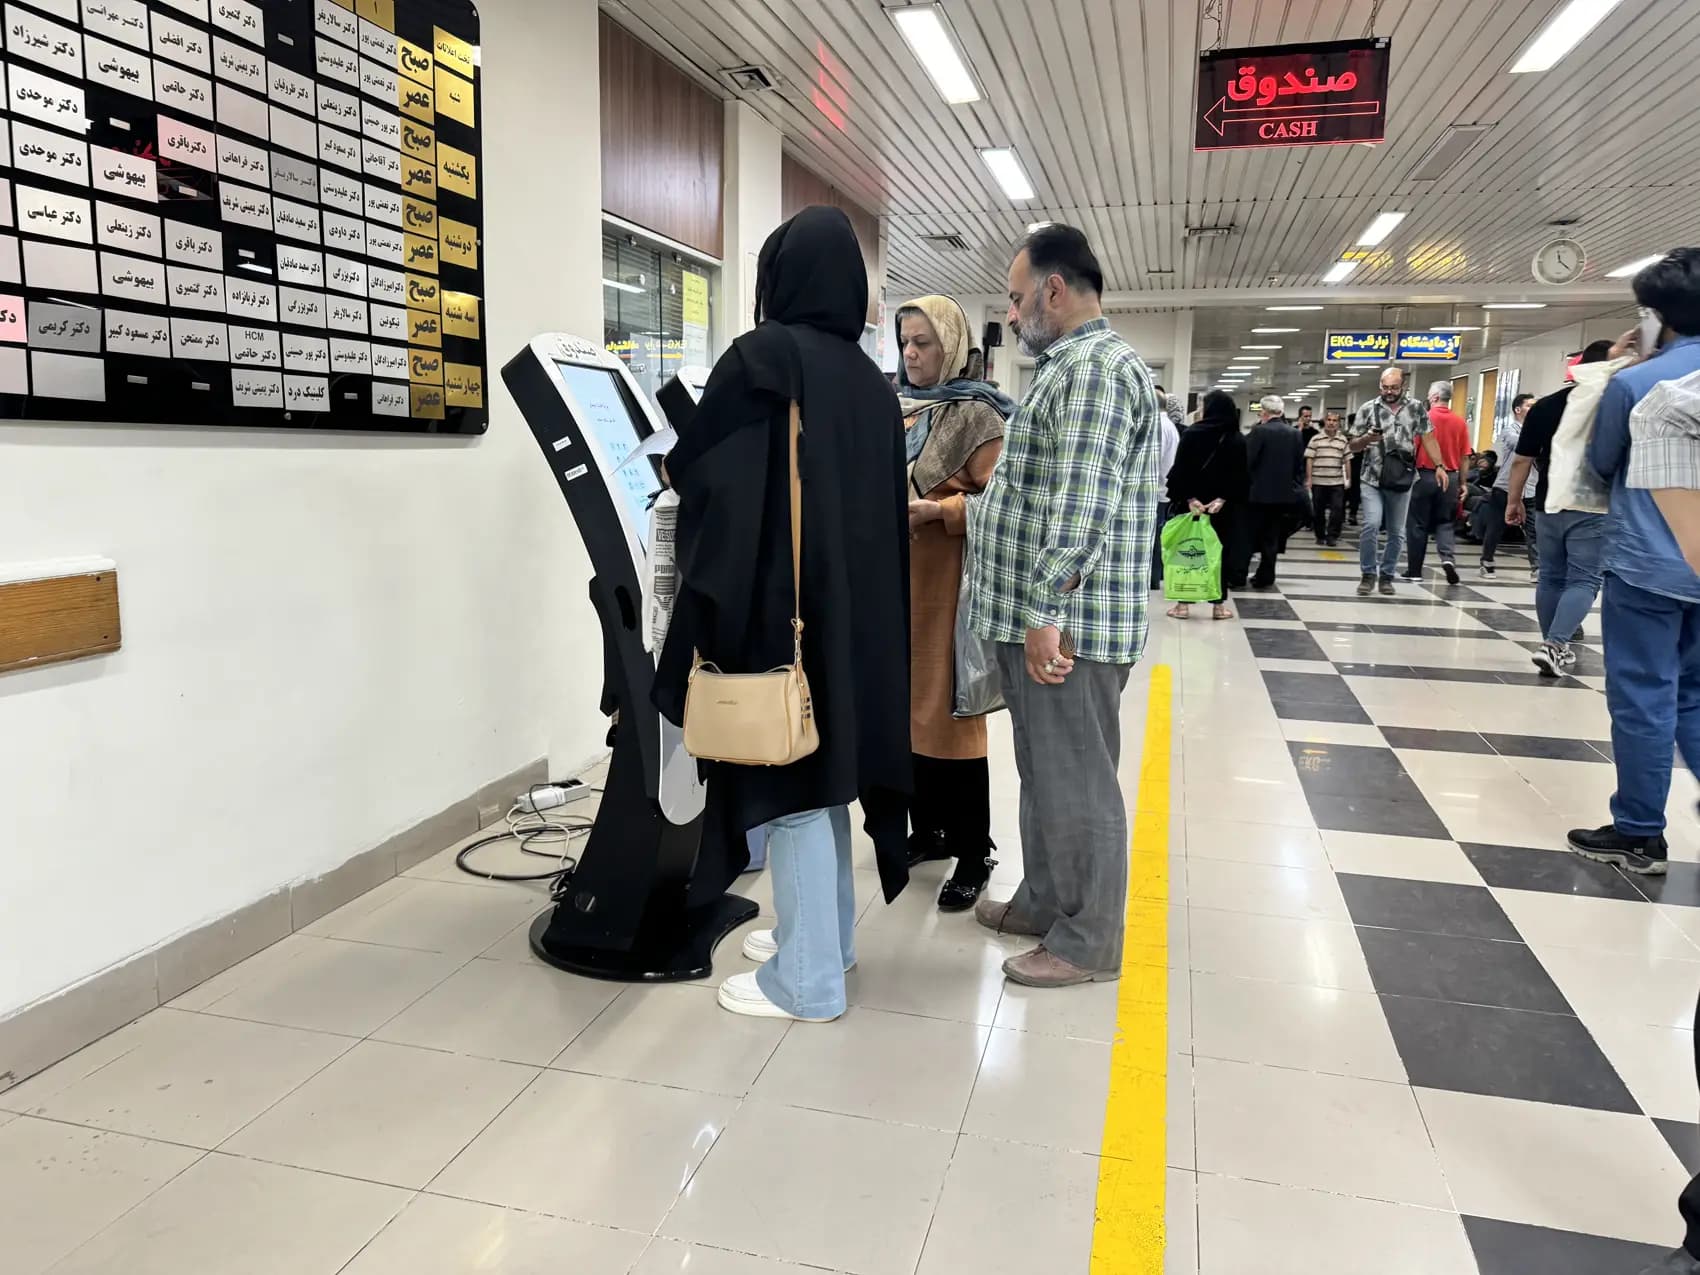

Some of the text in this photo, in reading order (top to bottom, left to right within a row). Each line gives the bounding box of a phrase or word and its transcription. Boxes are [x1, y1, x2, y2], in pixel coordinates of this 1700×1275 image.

[121, 17, 144, 29] دکتر
[242, 15, 256, 28] دکتر
[342, 22, 356, 34] دکتر
[13, 25, 75, 57] دکتر شیرزاد
[159, 32, 202, 54] دکتر افضلی
[385, 44, 397, 55] دکتر
[401, 46, 430, 73] صبح
[98, 57, 140, 83] بیهوشی
[249, 64, 260, 77] دکتر
[345, 61, 357, 73] دکتر
[385, 81, 396, 92] دکتر
[1226, 65, 1358, 106] صندوق
[188, 89, 205, 101] دکتر
[296, 87, 309, 99] دکتر
[402, 90, 430, 108] عصر
[57, 99, 78, 114] دکتر
[343, 106, 357, 117] دکتر
[388, 124, 399, 135] دکتر
[1258, 120, 1319, 139] CASH
[403, 125, 431, 151] صبح
[60, 152, 82, 166] دکتر
[346, 147, 356, 158] دکتر
[249, 160, 264, 171] دکتر
[387, 160, 399, 171] دکتر
[103, 163, 146, 188] بیهوشی
[405, 168, 432, 186] عصر
[443, 161, 470, 185] یکشنبه
[348, 190, 360, 202] دکتر
[27, 205, 82, 225] دکتر عباسی
[256, 203, 270, 217] دکتر
[389, 203, 400, 213] دکتر
[406, 203, 433, 228] صبح
[106, 219, 152, 239] دکتر زینعلی
[306, 219, 317, 231] دکتر
[348, 228, 361, 240] دکتر
[175, 236, 213, 254] دکتر باقری
[391, 242, 402, 252] دکتر
[445, 234, 472, 255] دوشنبه
[407, 244, 434, 263] عصر
[310, 263, 320, 275] دکتر
[112, 270, 154, 289] بیهوشی
[202, 284, 218, 298] دکتر
[409, 279, 436, 303] صبح
[257, 295, 270, 308] دکتر
[352, 310, 362, 322] دکتر
[445, 306, 476, 323] سه شنبه
[38, 319, 90, 337] دکتر کریمی
[412, 319, 437, 338] عصر
[151, 330, 168, 344] دکتر
[205, 334, 220, 348] دکتر
[244, 330, 265, 341] HCM
[1399, 335, 1461, 352] آزمایشگاه
[234, 347, 277, 362] دکتر حاتمی
[314, 349, 326, 361] دکتر
[357, 352, 368, 363] دکتر
[412, 355, 439, 377] صبح
[267, 383, 280, 397] دکتر
[288, 385, 325, 401] کلینیک درد
[416, 391, 440, 412] عصر
